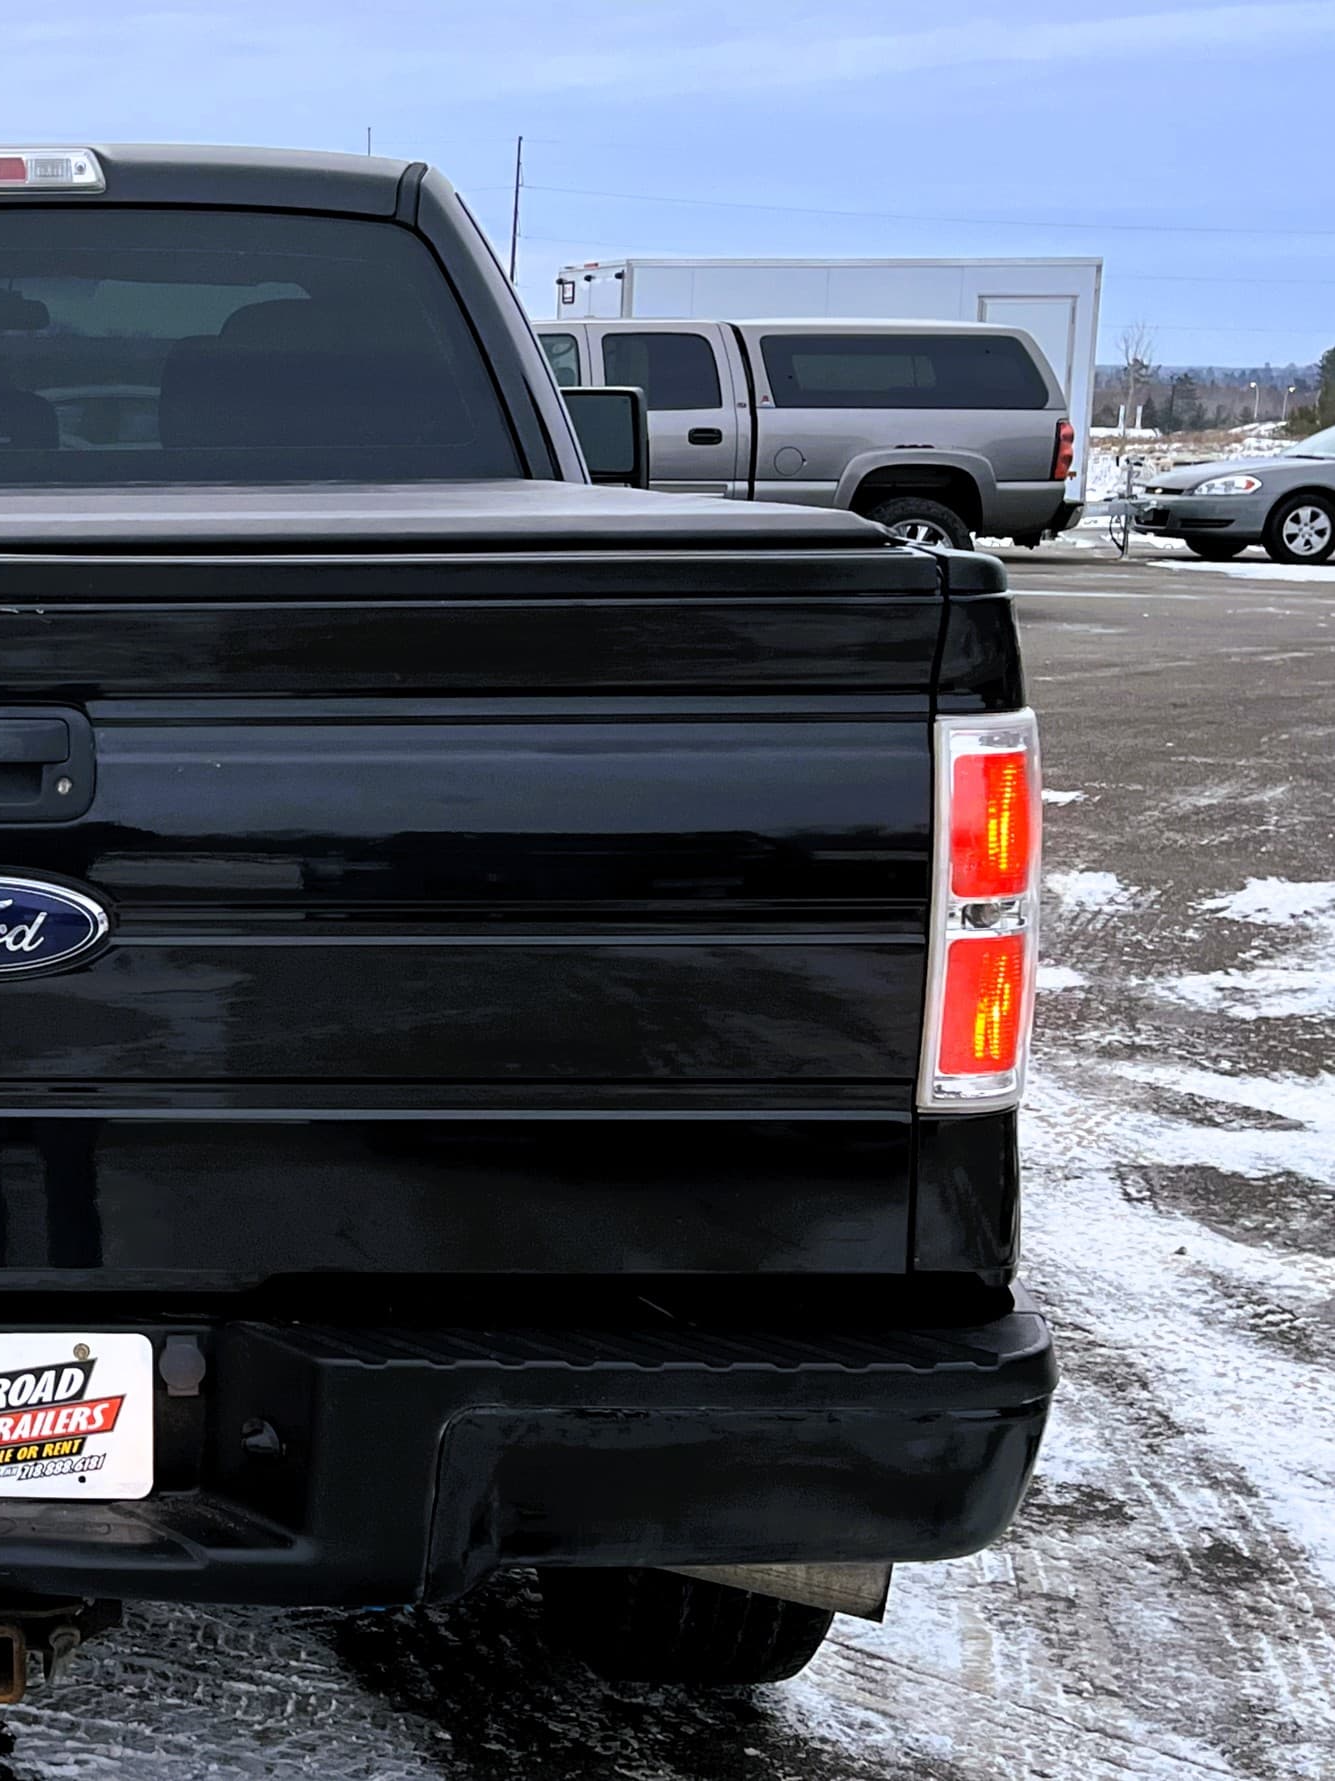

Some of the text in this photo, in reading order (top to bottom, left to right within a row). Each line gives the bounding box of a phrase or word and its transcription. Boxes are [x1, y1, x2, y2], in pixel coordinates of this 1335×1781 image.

[16, 1446, 40, 1461] OR
[42, 1439, 82, 1457] RENT
[19, 1454, 106, 1480] 218.888.6181
